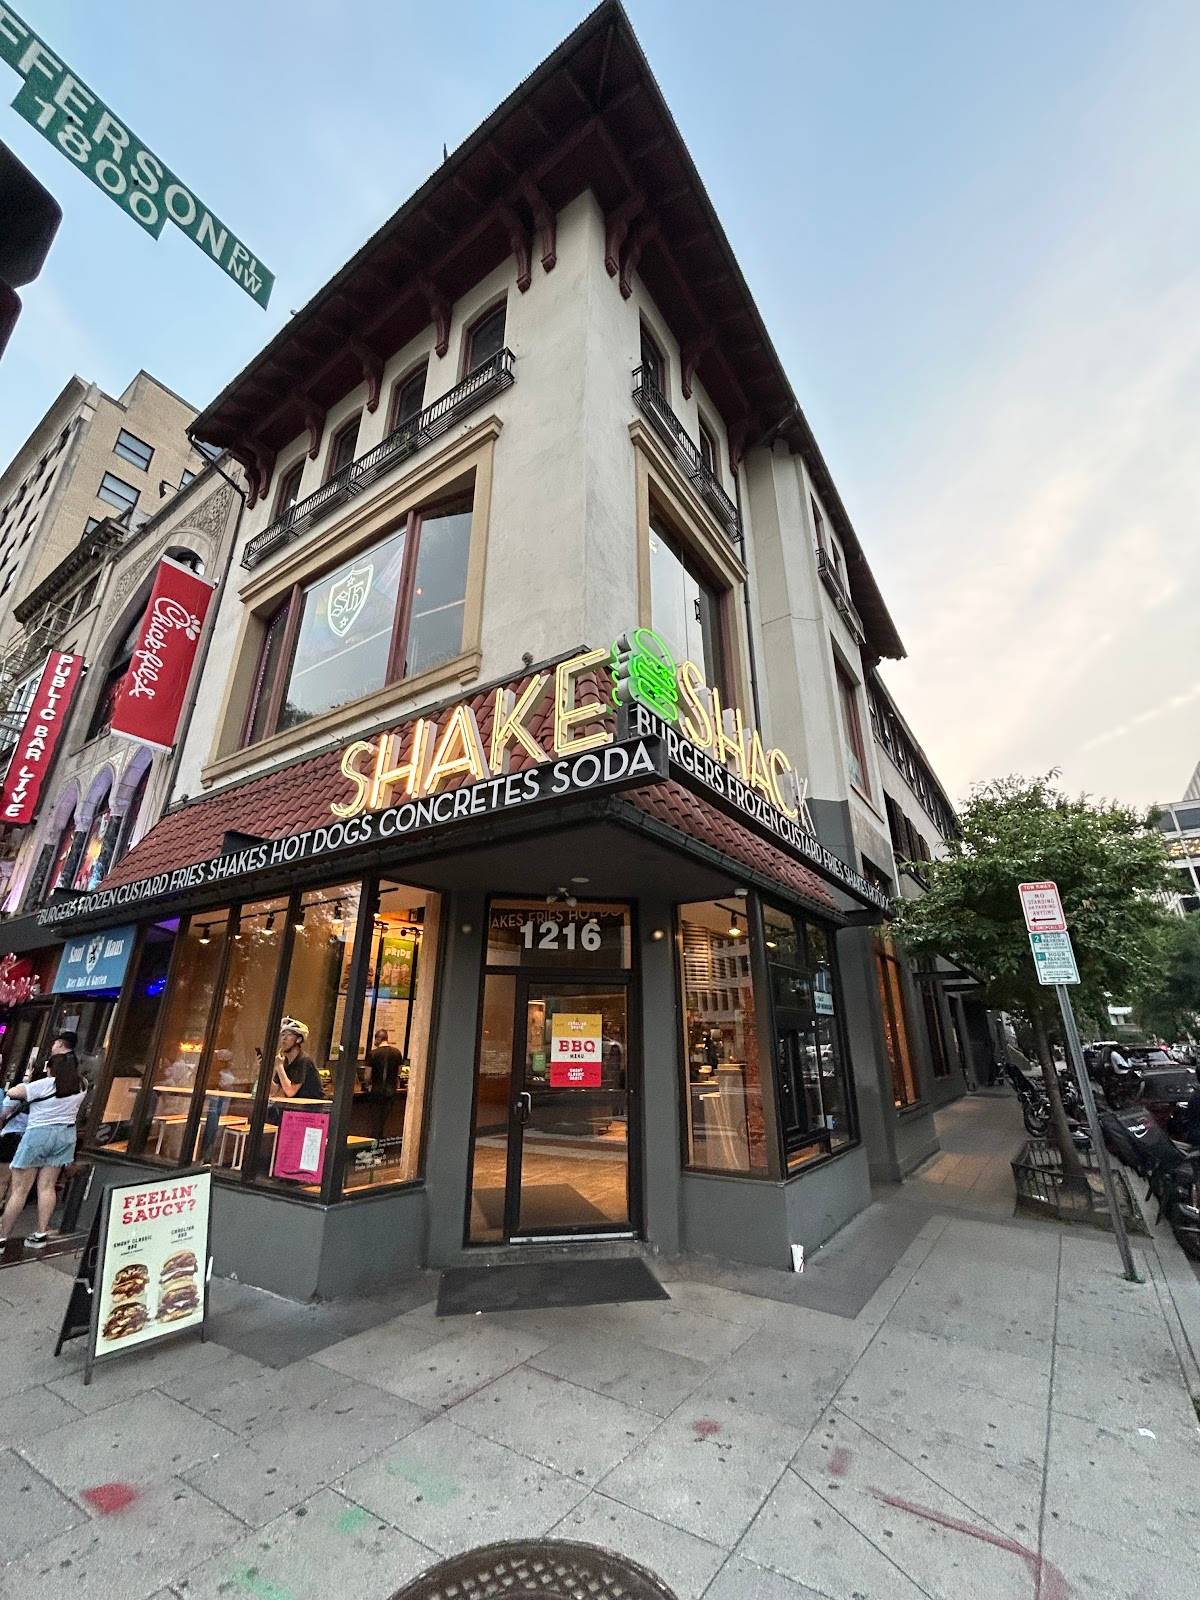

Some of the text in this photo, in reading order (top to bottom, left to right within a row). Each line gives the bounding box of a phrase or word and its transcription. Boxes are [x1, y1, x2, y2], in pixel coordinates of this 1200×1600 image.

[35, 96, 158, 225] 1800
[228, 256, 262, 294] NW
[233, 242, 262, 282] PL
[129, 597, 191, 700] Chick-fil-A
[5, 655, 74, 817] PUBLIC BAR LIVE
[331, 648, 613, 819] SHAKE
[677, 660, 816, 837] SHACK
[637, 703, 724, 793] BURGERS
[727, 774, 779, 830] FROZEN
[780, 816, 822, 863] CUSTARD
[822, 848, 844, 880] FRIES
[38, 741, 656, 925] BURGERS FROZEN CUSTARD FRIES SHAKES HOT DOGS CONCRETES SODA
[384, 946, 411, 960] PRIDE
[520, 920, 602, 952] 1216
[558, 1040, 596, 1054] BBQ
[122, 1198, 197, 1225] SAUCY?
[123, 1184, 198, 1209] FEELIN'
